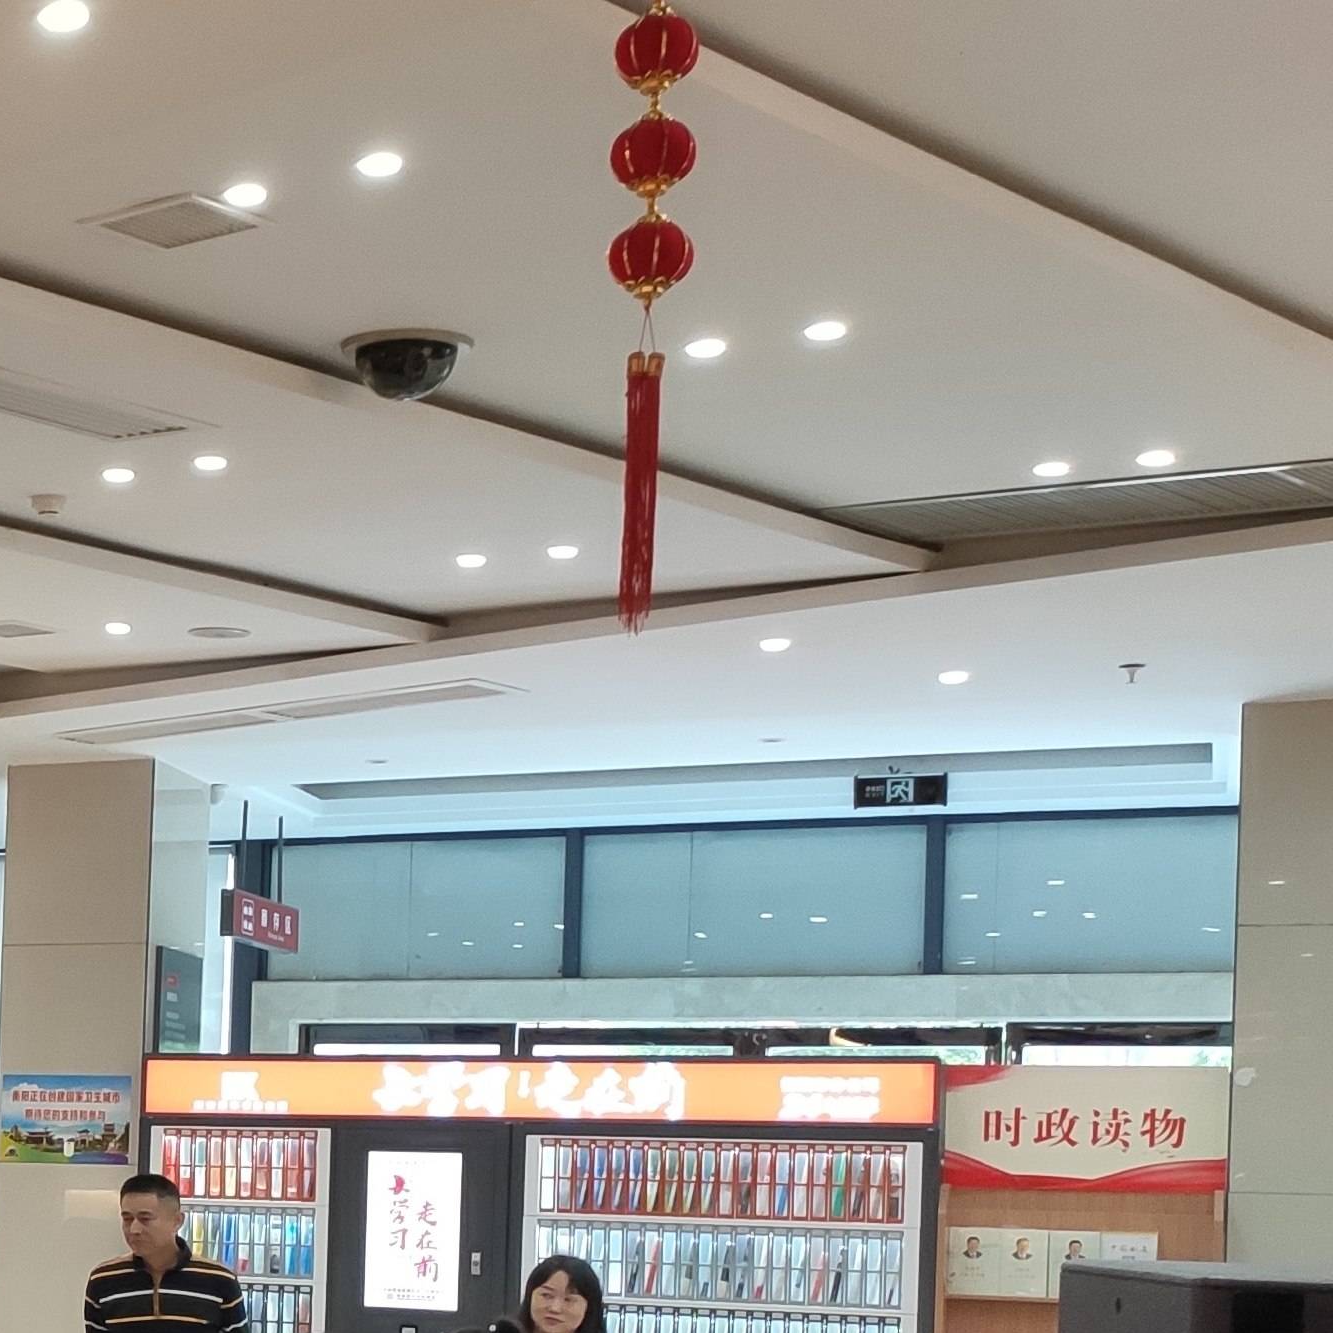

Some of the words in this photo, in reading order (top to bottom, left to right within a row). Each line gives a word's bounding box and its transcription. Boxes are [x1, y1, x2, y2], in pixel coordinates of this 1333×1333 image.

[983, 1106, 1187, 1151] 时政读物
[388, 1174, 410, 1250] 大学习
[414, 1200, 439, 1283] 走在前
